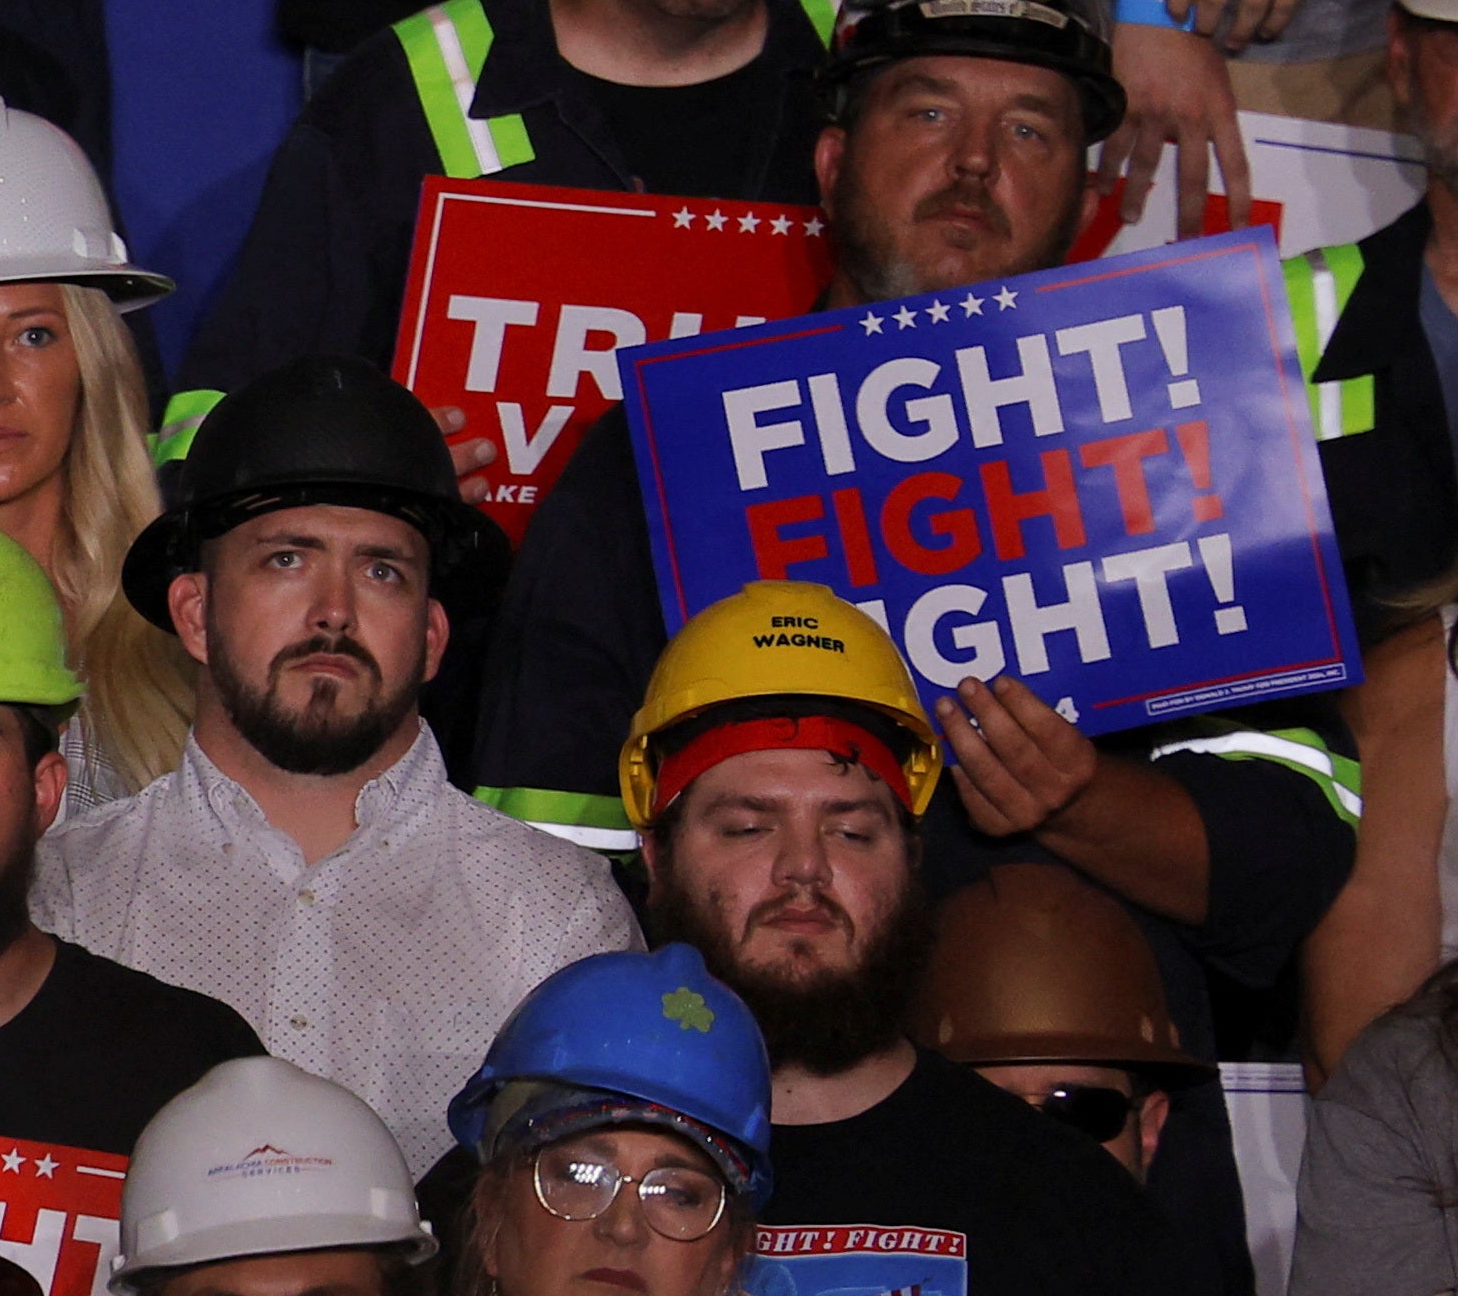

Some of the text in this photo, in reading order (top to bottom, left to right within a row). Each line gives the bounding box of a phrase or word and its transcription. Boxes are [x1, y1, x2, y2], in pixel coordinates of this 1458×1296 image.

[721, 304, 1202, 491] FIGHT!
[745, 420, 1223, 587] FIGHT!
[771, 615, 819, 630] ERIC
[753, 634, 845, 653] WAGNER
[844, 1230, 961, 1253] FIGHT!
